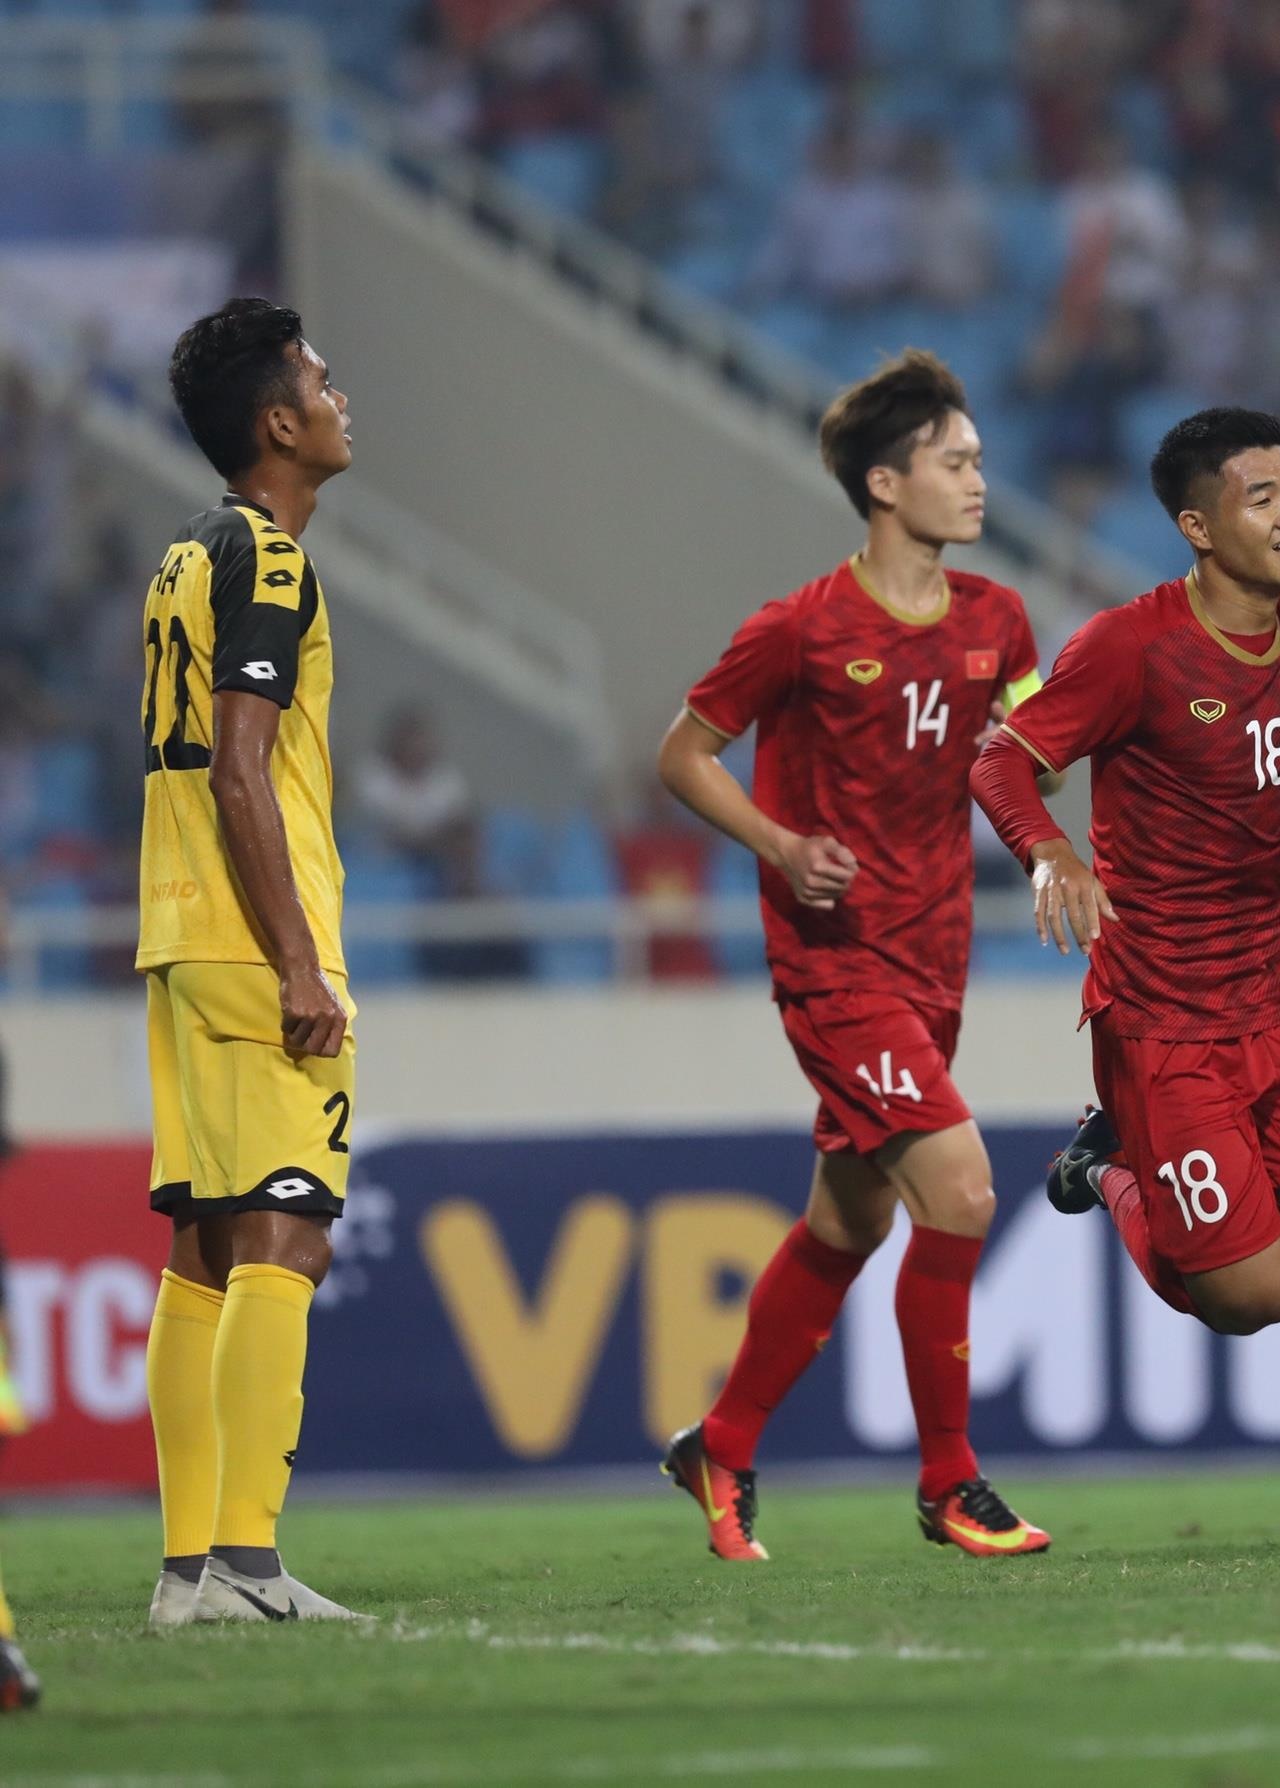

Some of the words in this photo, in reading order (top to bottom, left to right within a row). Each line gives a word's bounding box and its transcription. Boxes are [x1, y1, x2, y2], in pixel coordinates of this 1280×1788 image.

[902, 679, 950, 751] 14
[855, 1050, 923, 1111] 14
[323, 1090, 350, 1154] 2
[1157, 1149, 1229, 1232] 18
